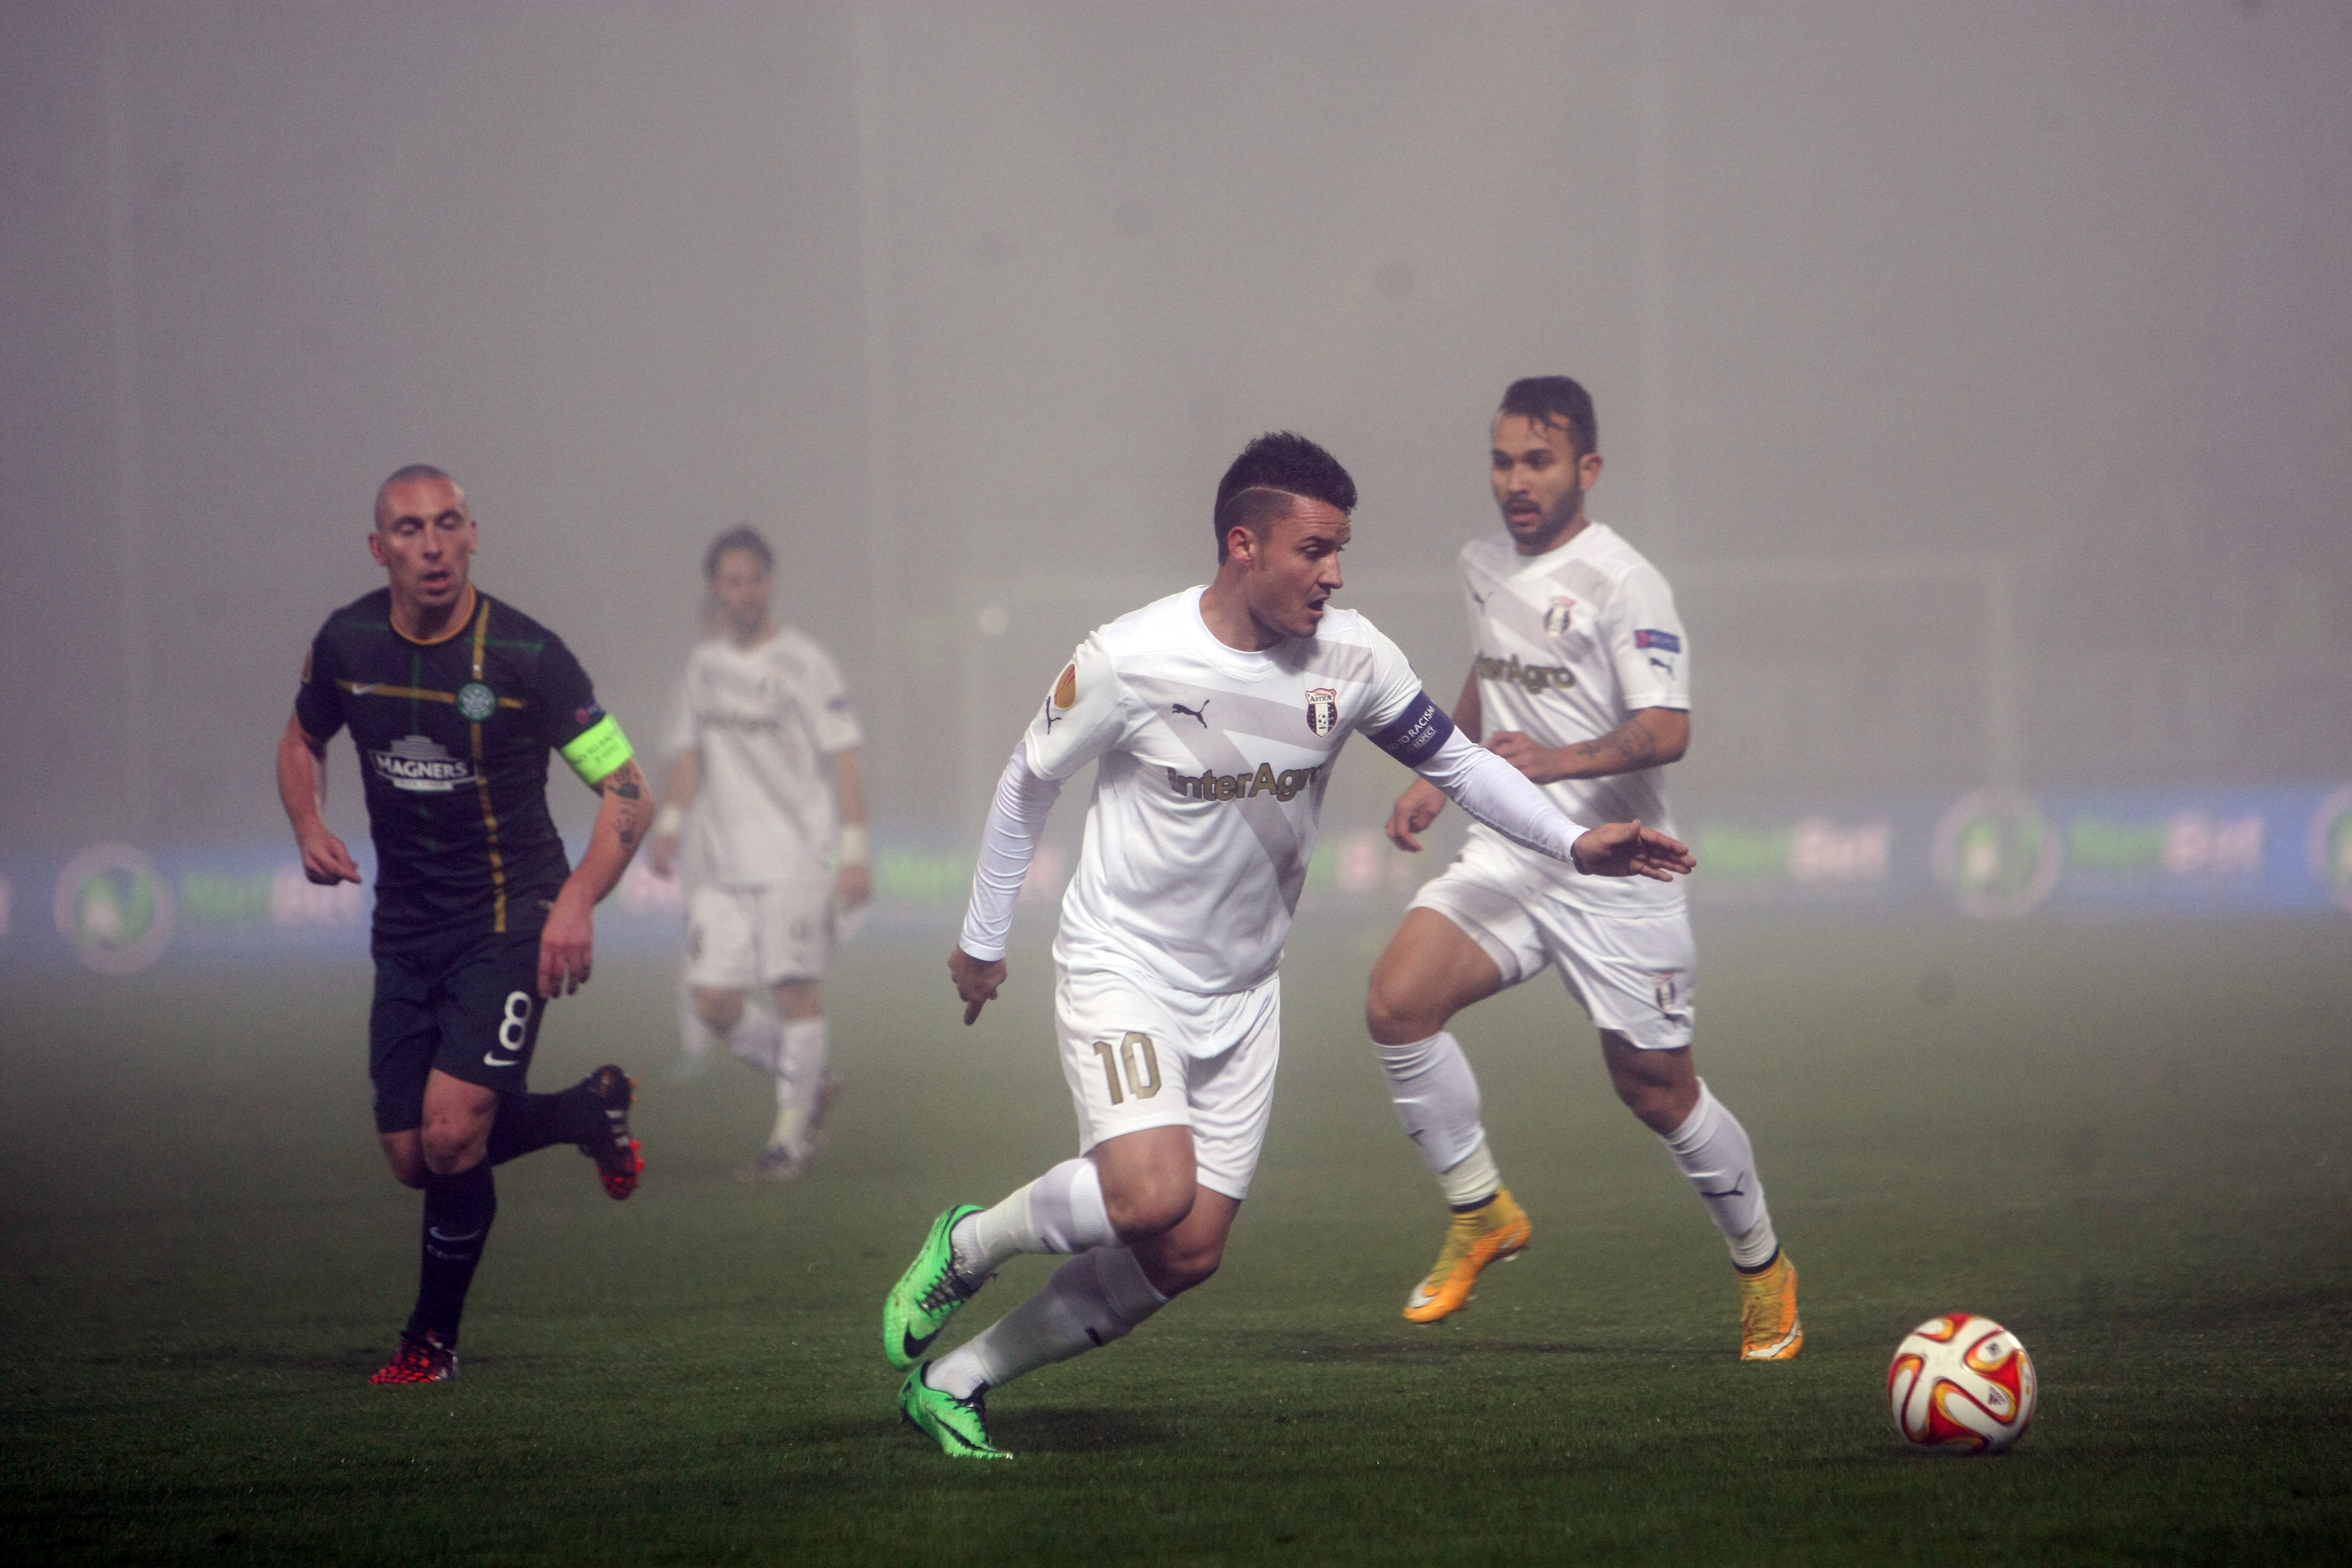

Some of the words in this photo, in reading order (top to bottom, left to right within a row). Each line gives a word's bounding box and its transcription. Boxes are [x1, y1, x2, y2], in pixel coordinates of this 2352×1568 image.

[1397, 735, 1410, 745] TO
[1408, 705, 1436, 737] RACISM
[1413, 727, 1435, 748] RESPECT
[375, 754, 468, 779] MAGNERS
[1166, 762, 1325, 802] InterAgr
[498, 990, 532, 1051] 8
[1093, 1031, 1161, 1106] 10
